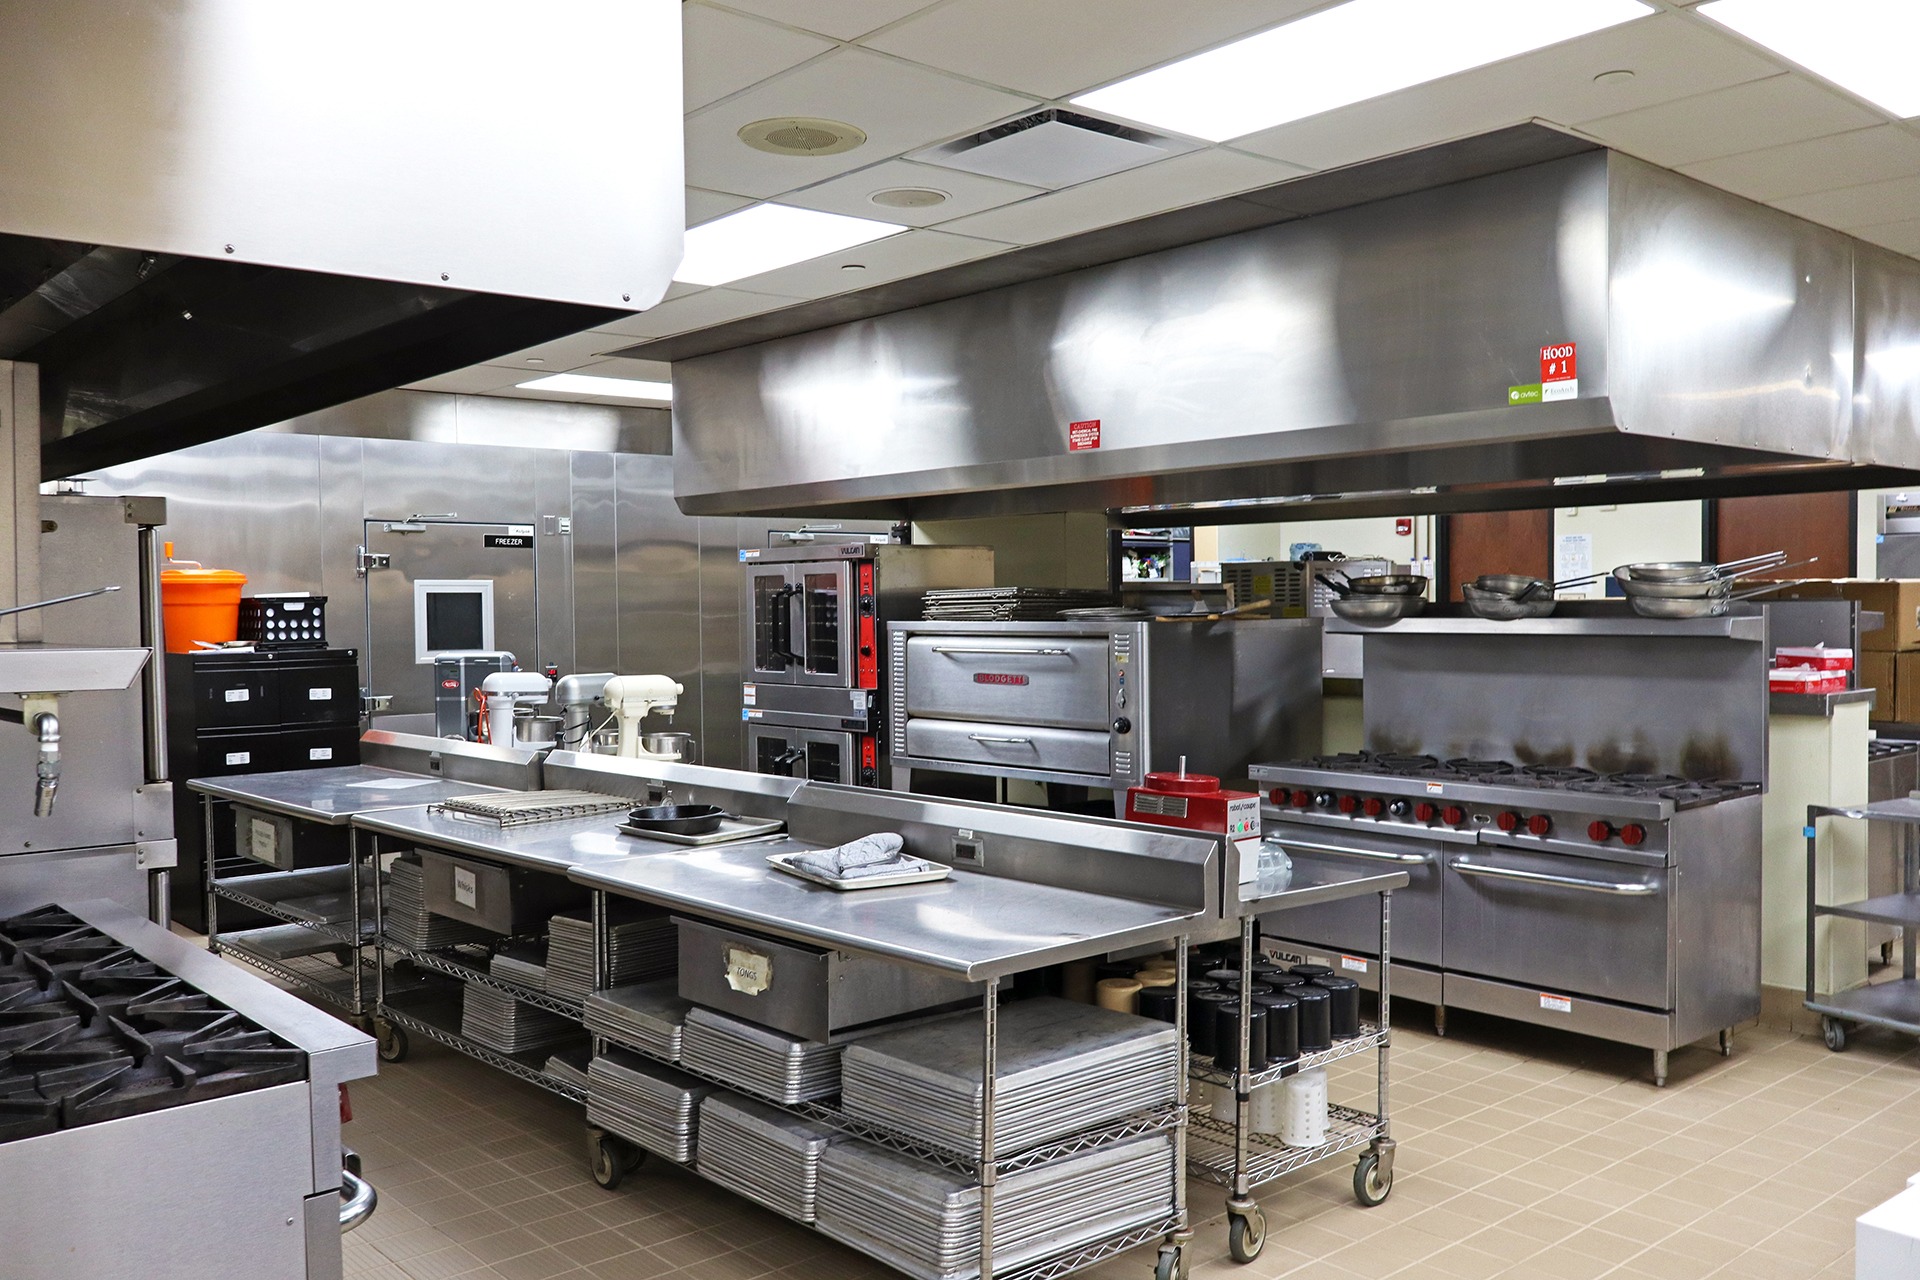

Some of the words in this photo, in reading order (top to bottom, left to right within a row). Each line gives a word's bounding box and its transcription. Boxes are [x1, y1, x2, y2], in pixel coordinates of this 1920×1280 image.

[1543, 346, 1573, 360] HOOD
[1549, 362, 1556, 375] #
[1561, 360, 1567, 373] 1
[840, 547, 860, 555] VULCAN
[979, 674, 1025, 684] BLODGETT
[1269, 950, 1302, 964] VULCAN
[737, 967, 757, 981] TONGS
